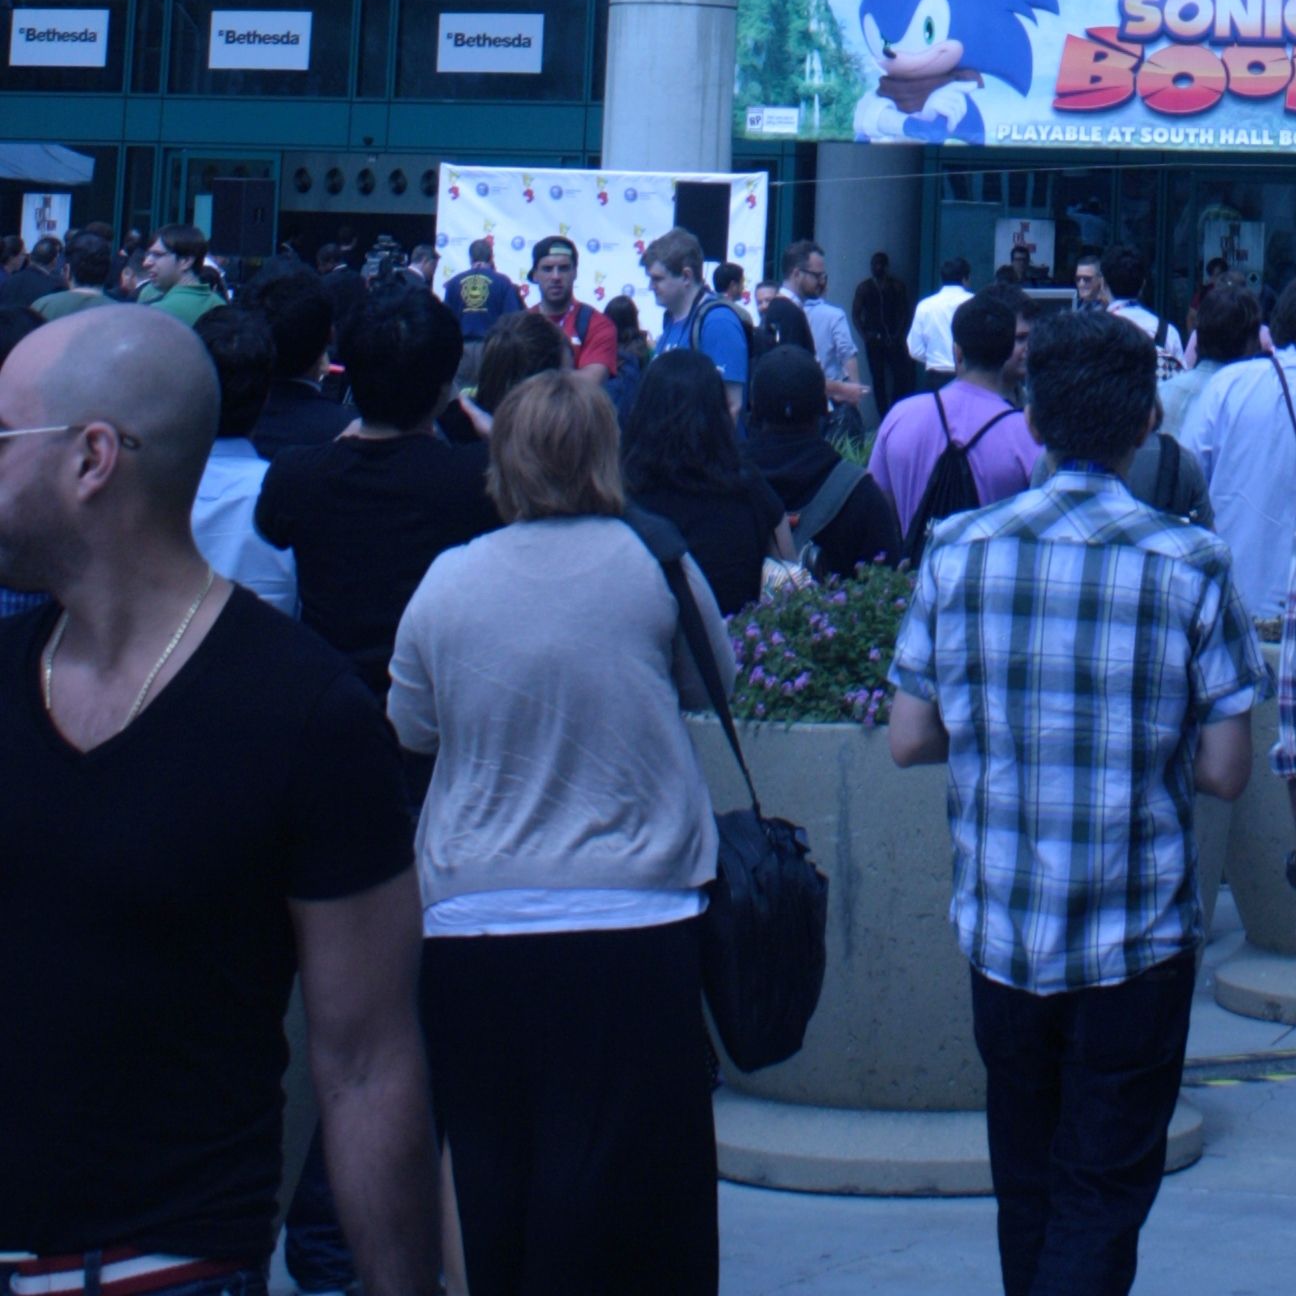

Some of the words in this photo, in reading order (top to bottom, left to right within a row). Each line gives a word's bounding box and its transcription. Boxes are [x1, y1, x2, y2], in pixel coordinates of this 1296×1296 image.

[25, 27, 98, 43] Bethesda
[224, 29, 300, 46] Bethesda
[453, 32, 532, 49] Bethesda
[997, 123, 1102, 143] PLAYABLE
[1107, 126, 1136, 144] AT
[1140, 126, 1214, 146] SOUTH
[1219, 128, 1274, 147] HALL
